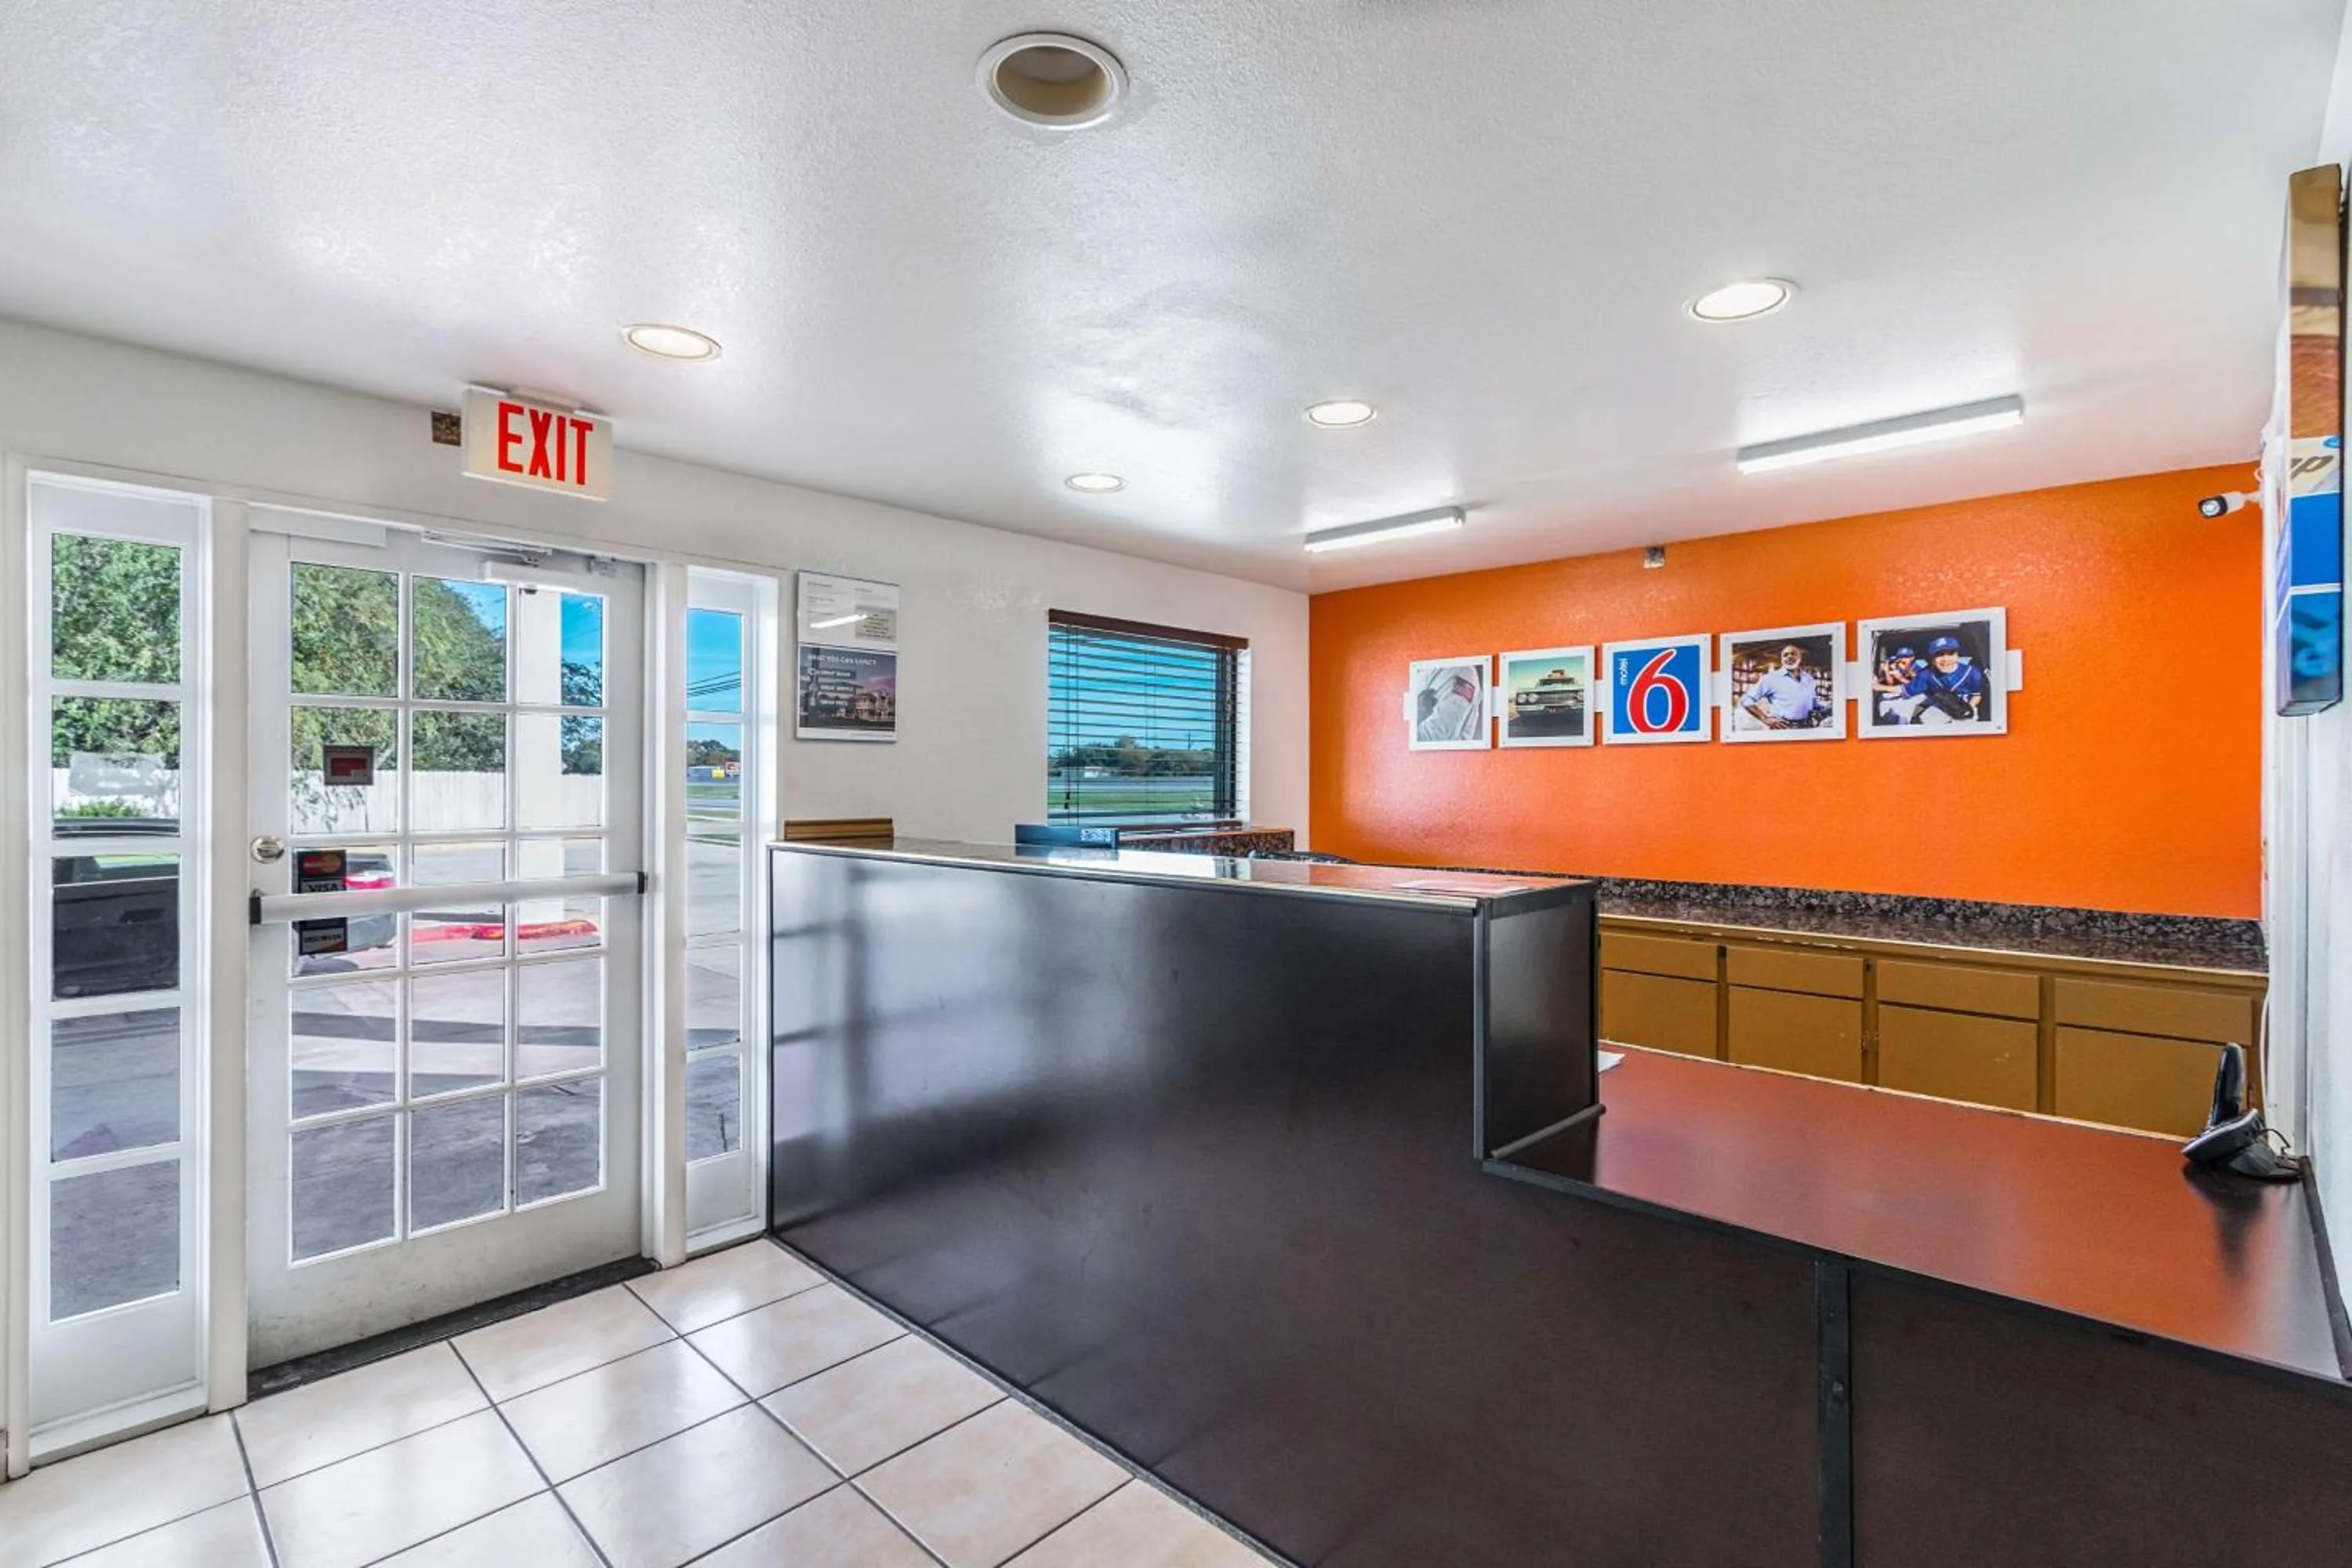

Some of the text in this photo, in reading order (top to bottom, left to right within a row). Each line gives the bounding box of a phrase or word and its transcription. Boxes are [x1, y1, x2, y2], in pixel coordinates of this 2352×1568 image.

[497, 401, 593, 485] EXIT
[1617, 648, 1690, 735] motel 6
[307, 882, 339, 892] VISA
